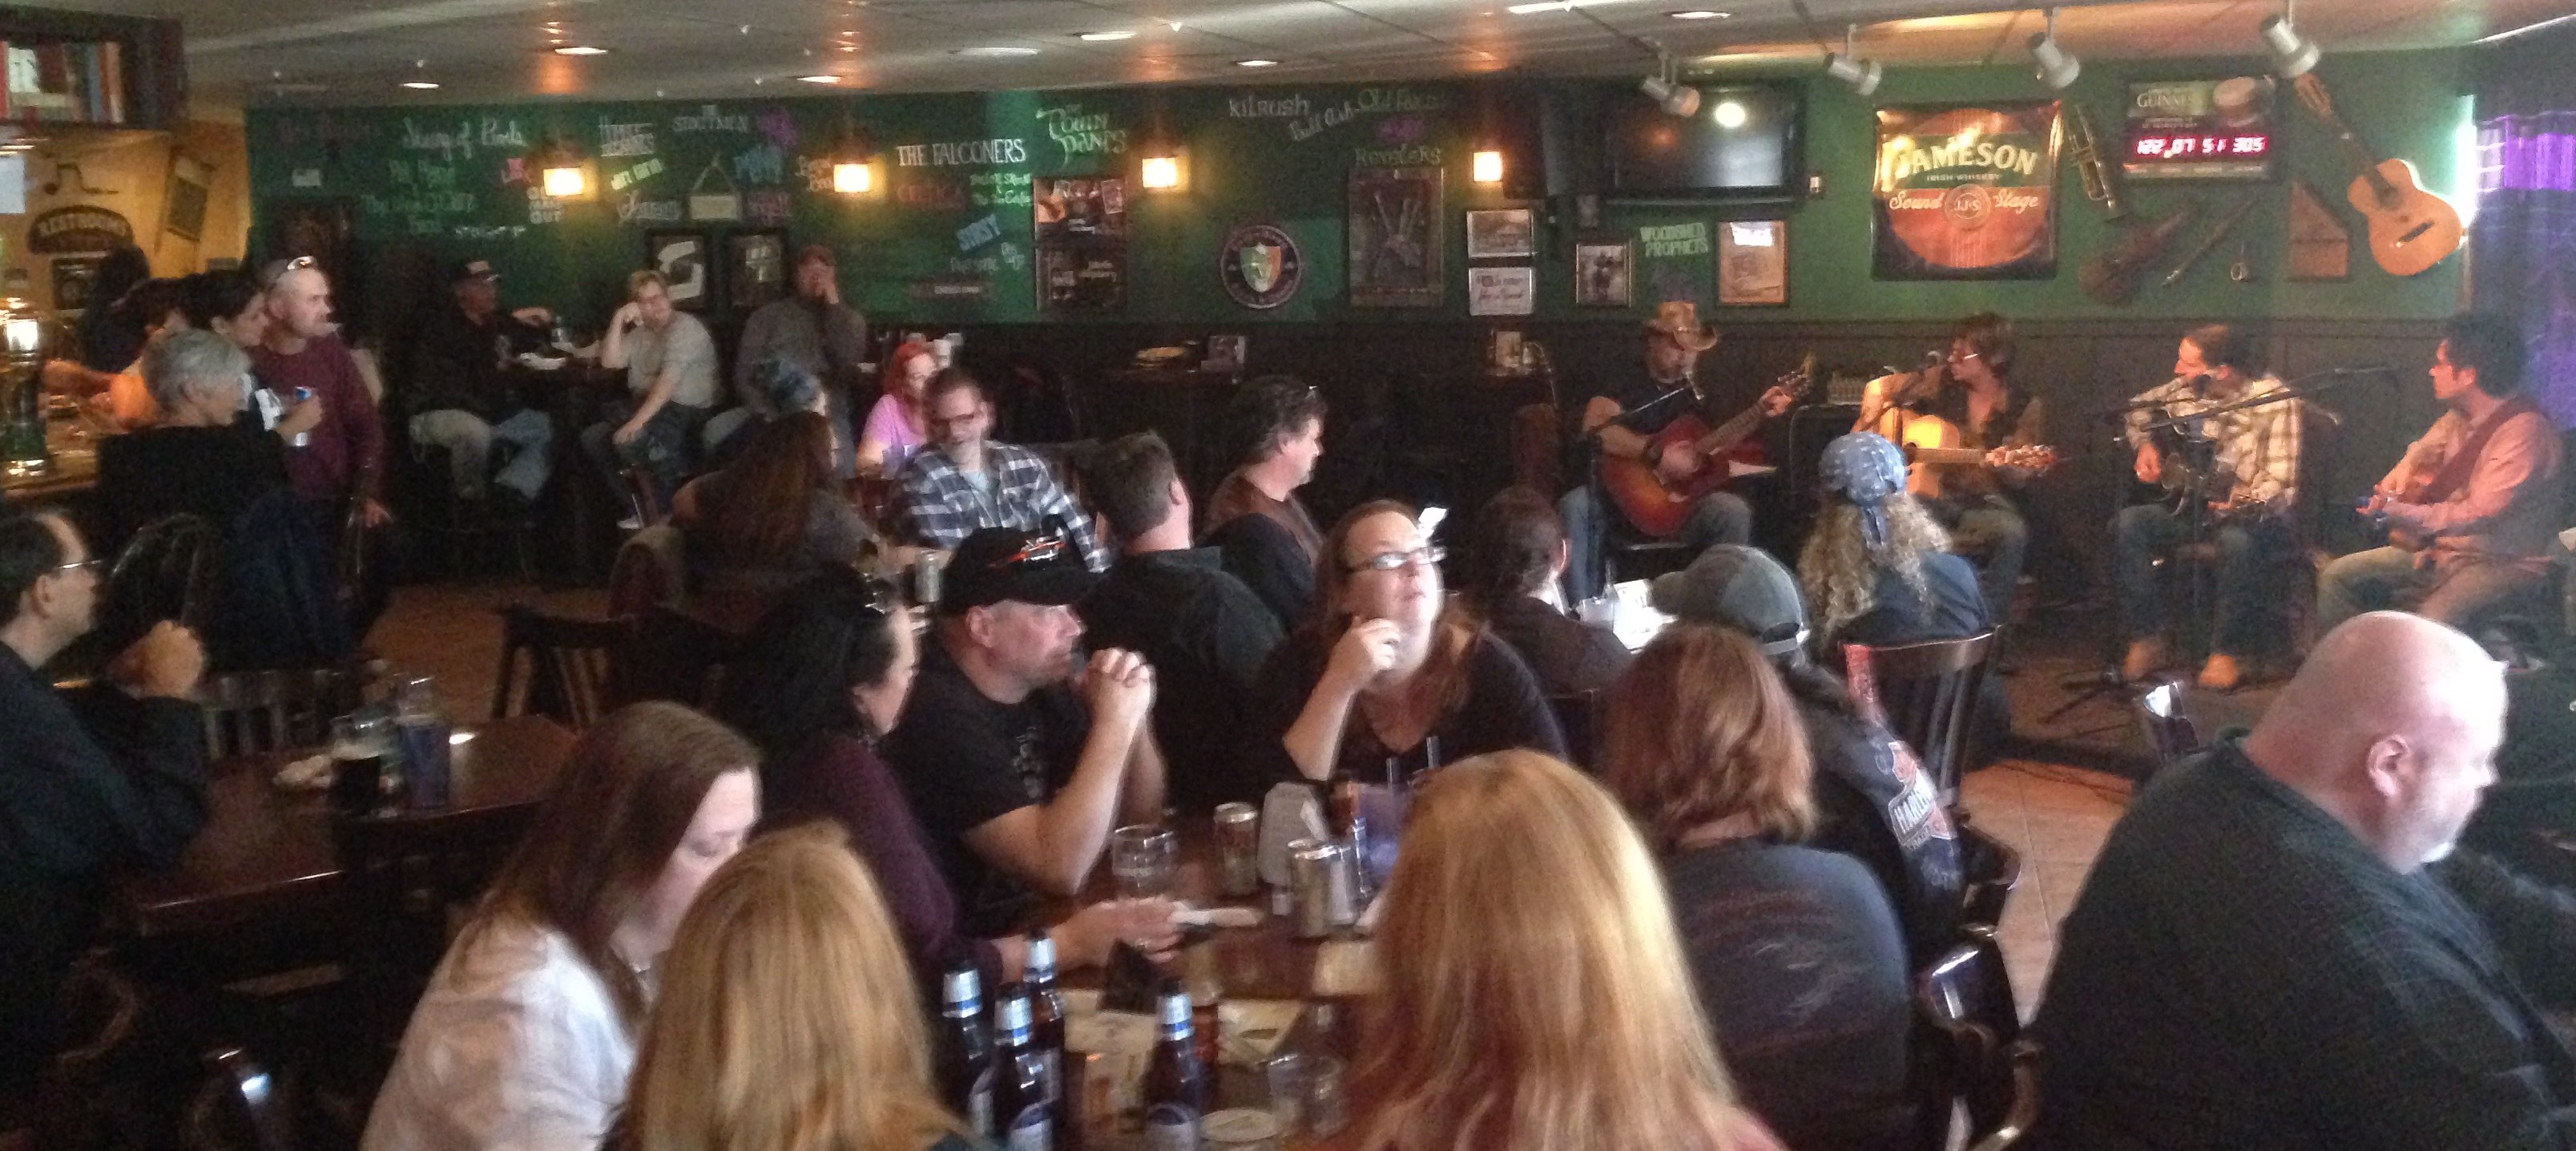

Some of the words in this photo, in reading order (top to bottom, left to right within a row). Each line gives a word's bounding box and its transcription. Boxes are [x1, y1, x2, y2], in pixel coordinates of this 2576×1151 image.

[897, 145, 927, 167] THE
[933, 139, 1026, 165] FALCONERS
[1894, 143, 2038, 180] JAMESON
[1927, 173, 1953, 181] IRISH
[1889, 190, 1946, 211] Sound
[1993, 188, 2040, 214] Stage
[1644, 238, 1708, 256] PROPHETS
